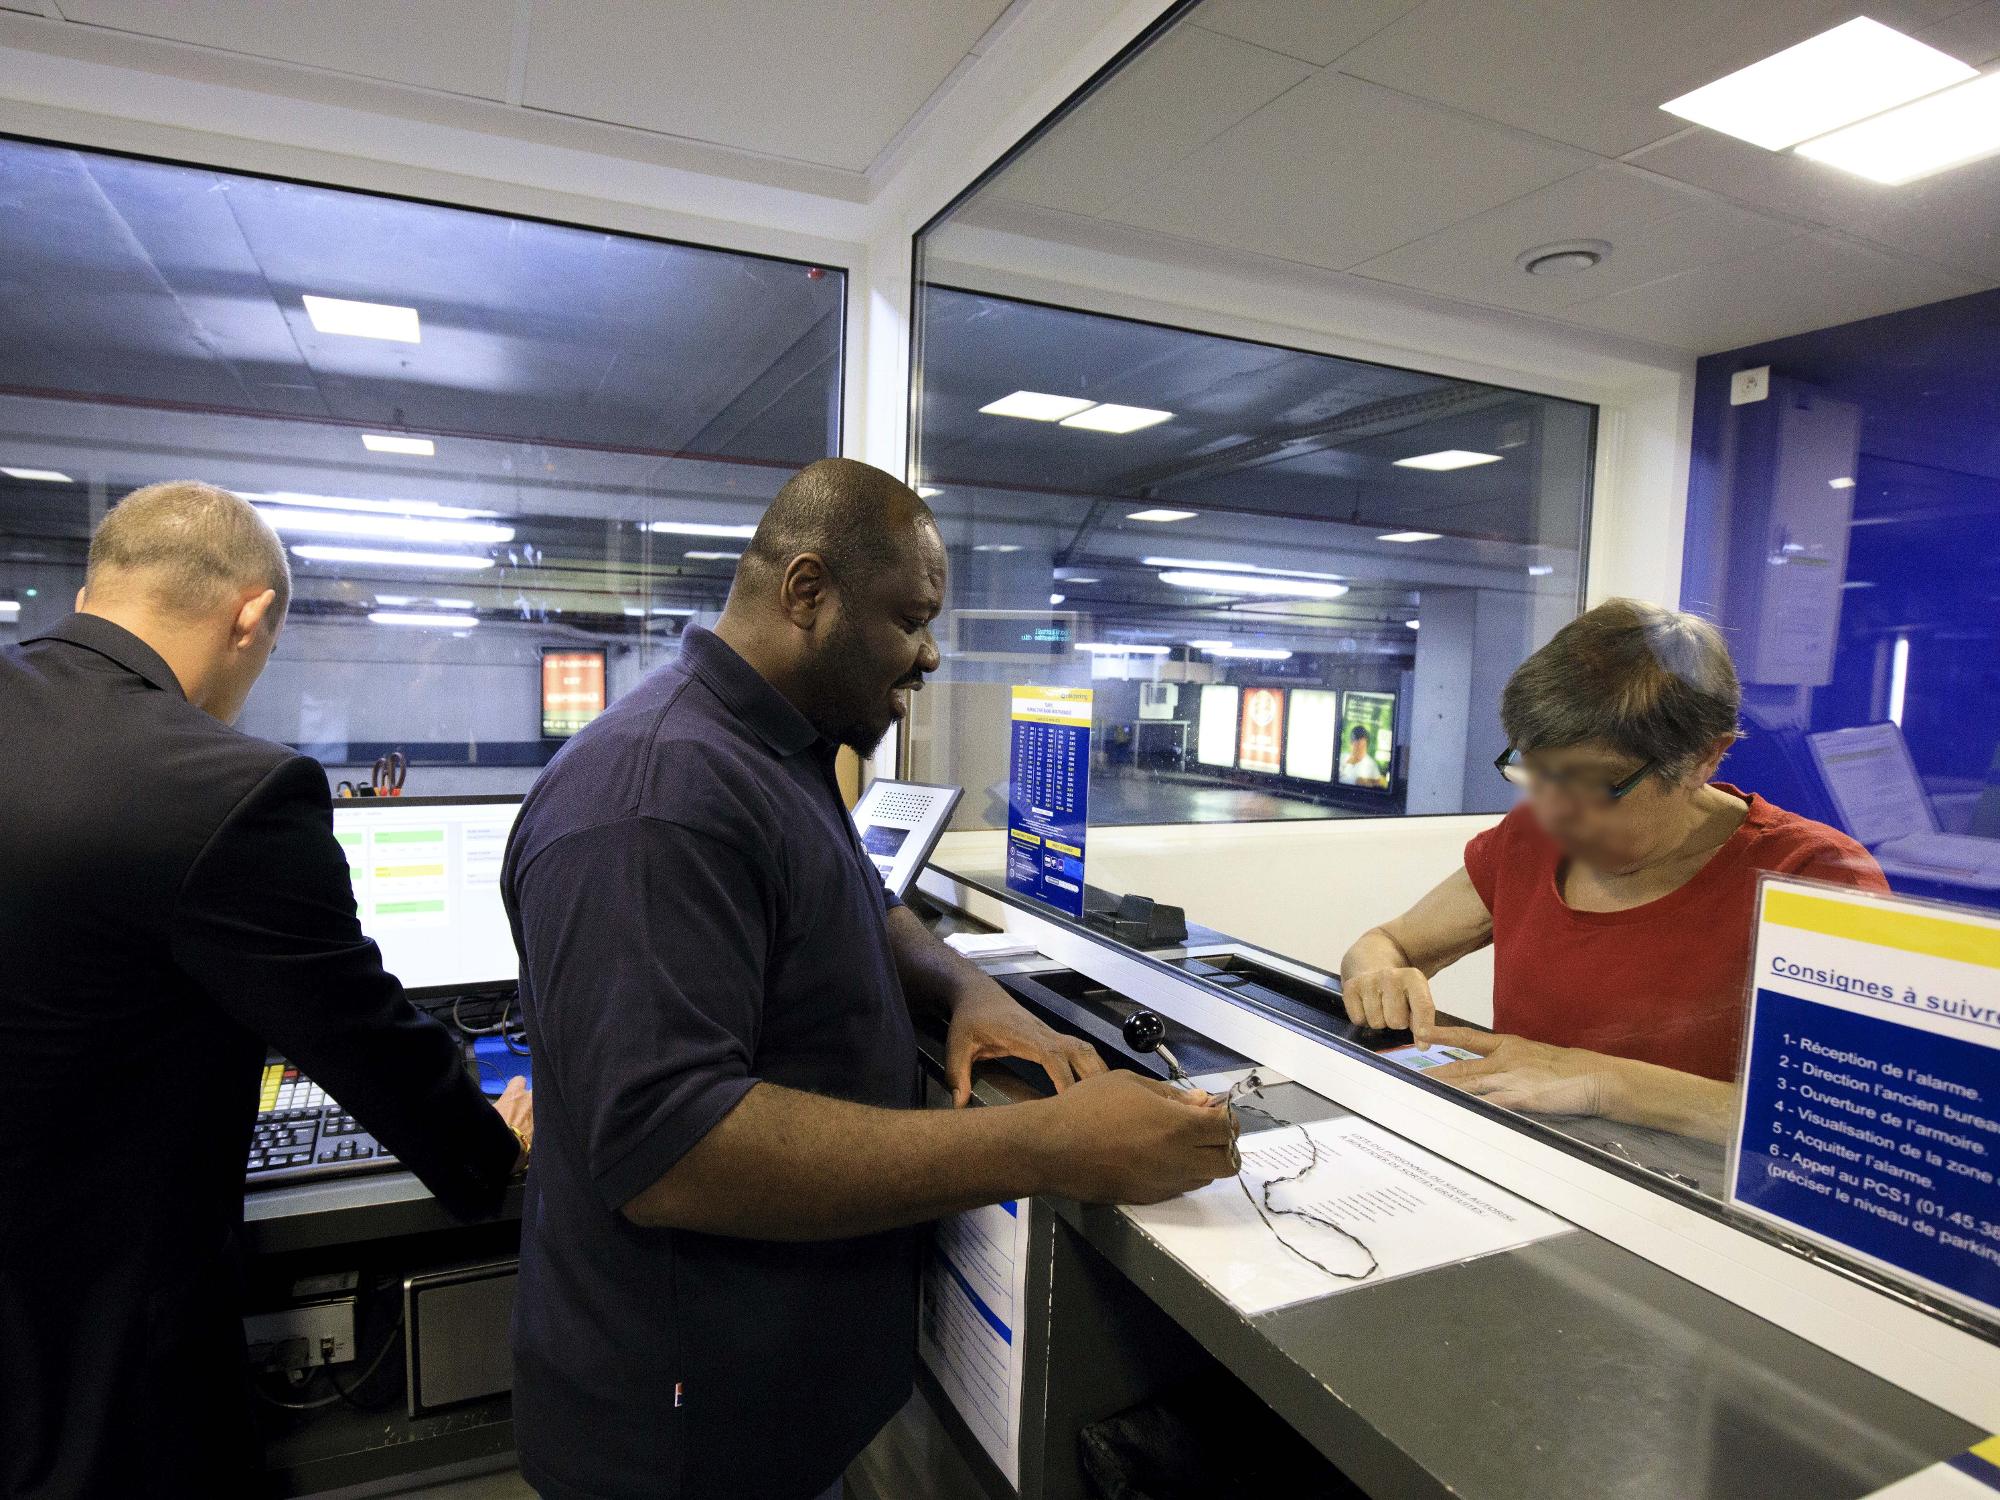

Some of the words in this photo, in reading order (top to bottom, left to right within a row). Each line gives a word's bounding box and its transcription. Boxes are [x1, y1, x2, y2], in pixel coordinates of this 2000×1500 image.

[1772, 957, 1893, 998] Consignes
[1903, 987, 1916, 1004] à
[1779, 1055, 1789, 1068] 2
[1803, 1062, 1869, 1093] Direction
[1874, 1083, 1938, 1114] l'ancien
[1943, 1105, 2000, 1134] burea
[1800, 1038, 1877, 1071] Réception
[1881, 1063, 1904, 1078] de
[1908, 1069, 1983, 1102] l'alarme.
[1774, 1100, 1784, 1112] 4
[1798, 1106, 1895, 1151] Visualisation
[1899, 1143, 1921, 1159] de
[1926, 1150, 1942, 1166] la
[1946, 1159, 1993, 1184] zone
[1777, 1078, 1787, 1090] 3
[1800, 1085, 1876, 1119] Ouverture
[1880, 1111, 1902, 1127] de
[1907, 1118, 1988, 1156] l'armoire.
[1769, 1144, 1780, 1157] 6
[1791, 1152, 1835, 1177] Appel
[1838, 1171, 1859, 1186] au
[1863, 1178, 1910, 1205] PCS1
[1772, 1122, 1782, 1134] 5
[1794, 1130, 1862, 1162] Acquitter
[1866, 1154, 1936, 1191] l'alarme.
[1767, 1162, 1833, 1196] (préciser
[1835, 1187, 1850, 1203] le
[1854, 1196, 1909, 1226] niveau
[1912, 1220, 1936, 1237] de
[1939, 1231, 2000, 1267] parkin
